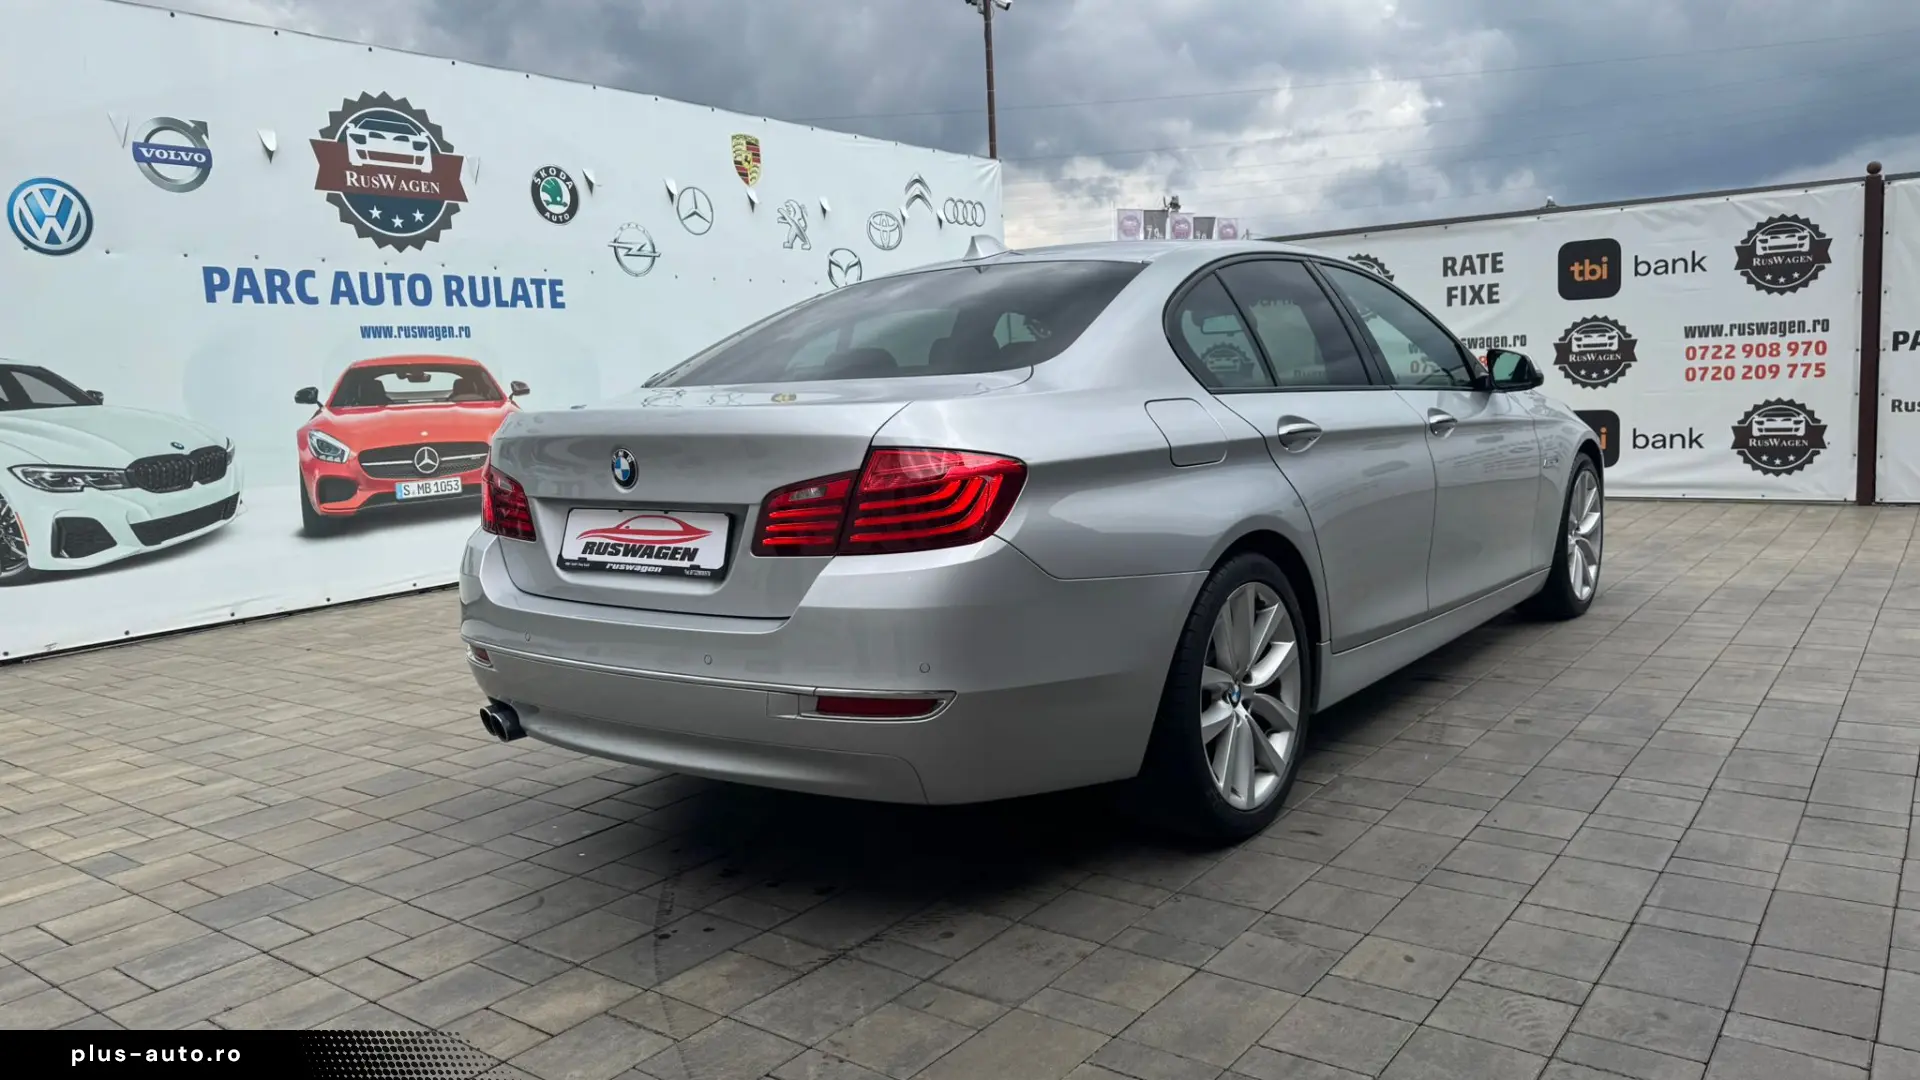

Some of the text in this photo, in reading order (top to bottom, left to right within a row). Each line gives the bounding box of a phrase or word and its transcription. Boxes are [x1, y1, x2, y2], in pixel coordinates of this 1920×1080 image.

[139, 147, 206, 163] VOLVO
[544, 212, 570, 222] AUTO
[1442, 252, 1504, 277] RATE
[1570, 250, 1707, 282] tbi bank
[202, 266, 566, 309] PARC AUTO RULATE
[1446, 283, 1500, 307] FIXE
[360, 325, 471, 340] www.ruswagen.ro
[1684, 319, 1830, 339] www.ruswagen.ro
[1684, 340, 1828, 361] 0722 908 970
[1684, 362, 1827, 382] 0720 209 775
[1632, 428, 1704, 450] bank
[434, 480, 459, 492] 1053
[581, 541, 699, 562] RUSWAGEN
[606, 563, 662, 572] ruswagen
